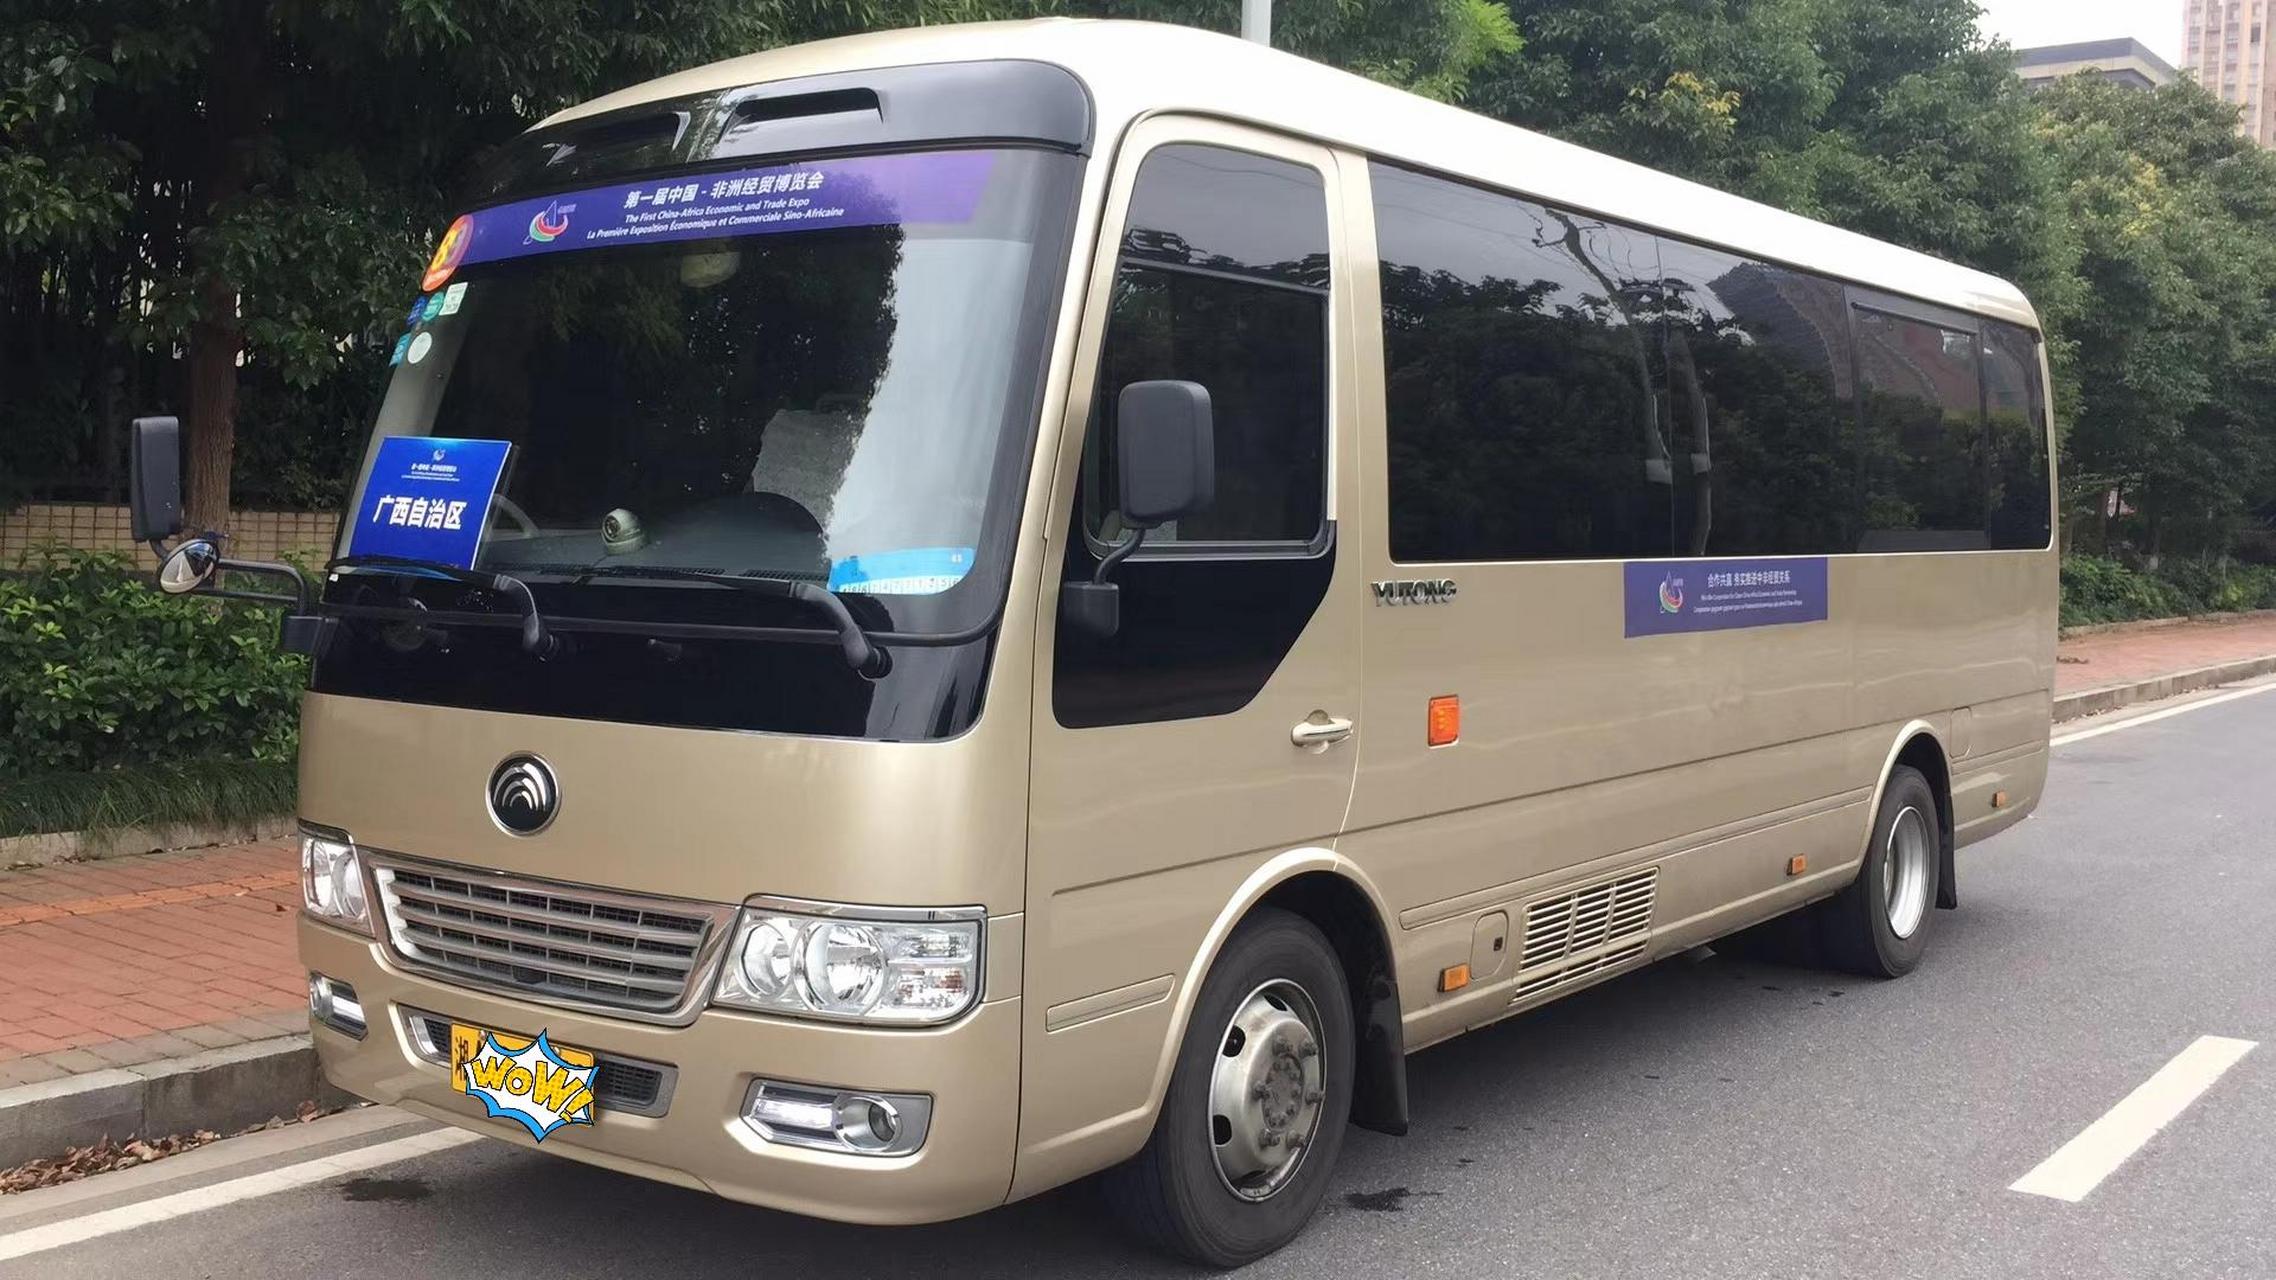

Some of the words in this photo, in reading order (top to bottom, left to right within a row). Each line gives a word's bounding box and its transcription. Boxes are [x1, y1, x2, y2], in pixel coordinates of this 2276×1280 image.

[624, 184, 699, 208] 第一届中国
[710, 171, 824, 198] 非洲经贸博览会
[587, 231, 595, 239] La
[630, 223, 667, 235] Exposition
[718, 215, 727, 226] et
[728, 212, 782, 225] Commerciale
[783, 208, 844, 220] Sino-Africaine
[625, 214, 638, 223] The
[640, 211, 656, 221] First
[658, 208, 704, 219] China-Africa
[705, 203, 743, 214] Economic
[745, 200, 761, 211] and
[763, 198, 786, 209] Trade
[788, 198, 810, 208] Expo
[373, 494, 467, 530] 广西自治区
[1371, 579, 1457, 606] YUTONG
